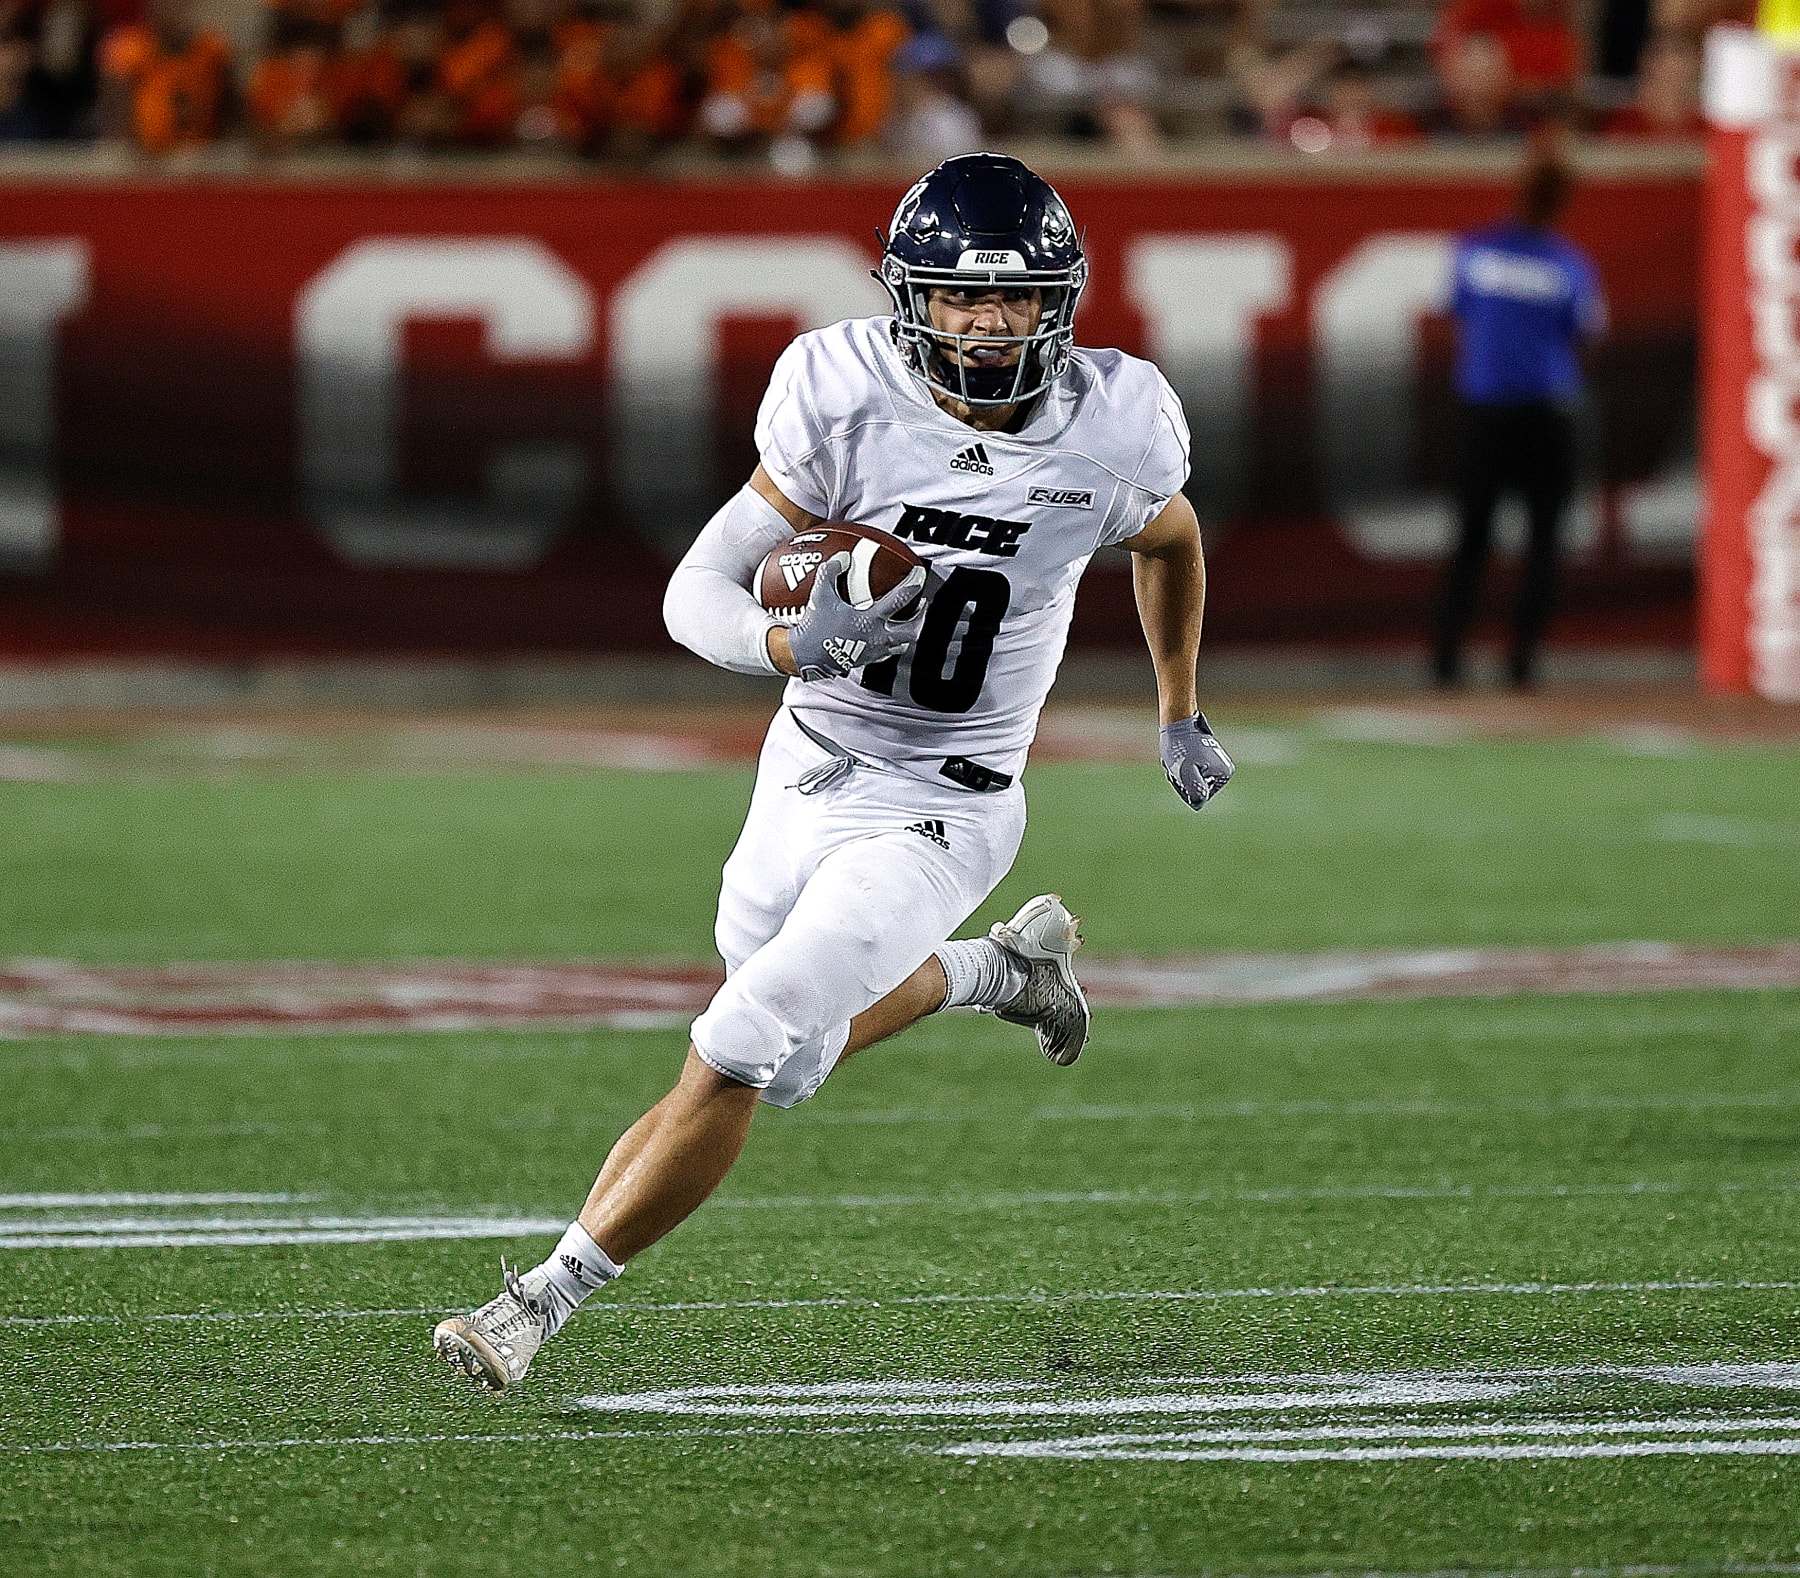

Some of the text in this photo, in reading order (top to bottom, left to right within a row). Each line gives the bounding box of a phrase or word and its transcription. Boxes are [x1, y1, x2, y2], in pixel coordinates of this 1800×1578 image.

[974, 252, 1009, 265] RICE
[950, 456, 994, 476] adidas
[892, 502, 1032, 557] RICE
